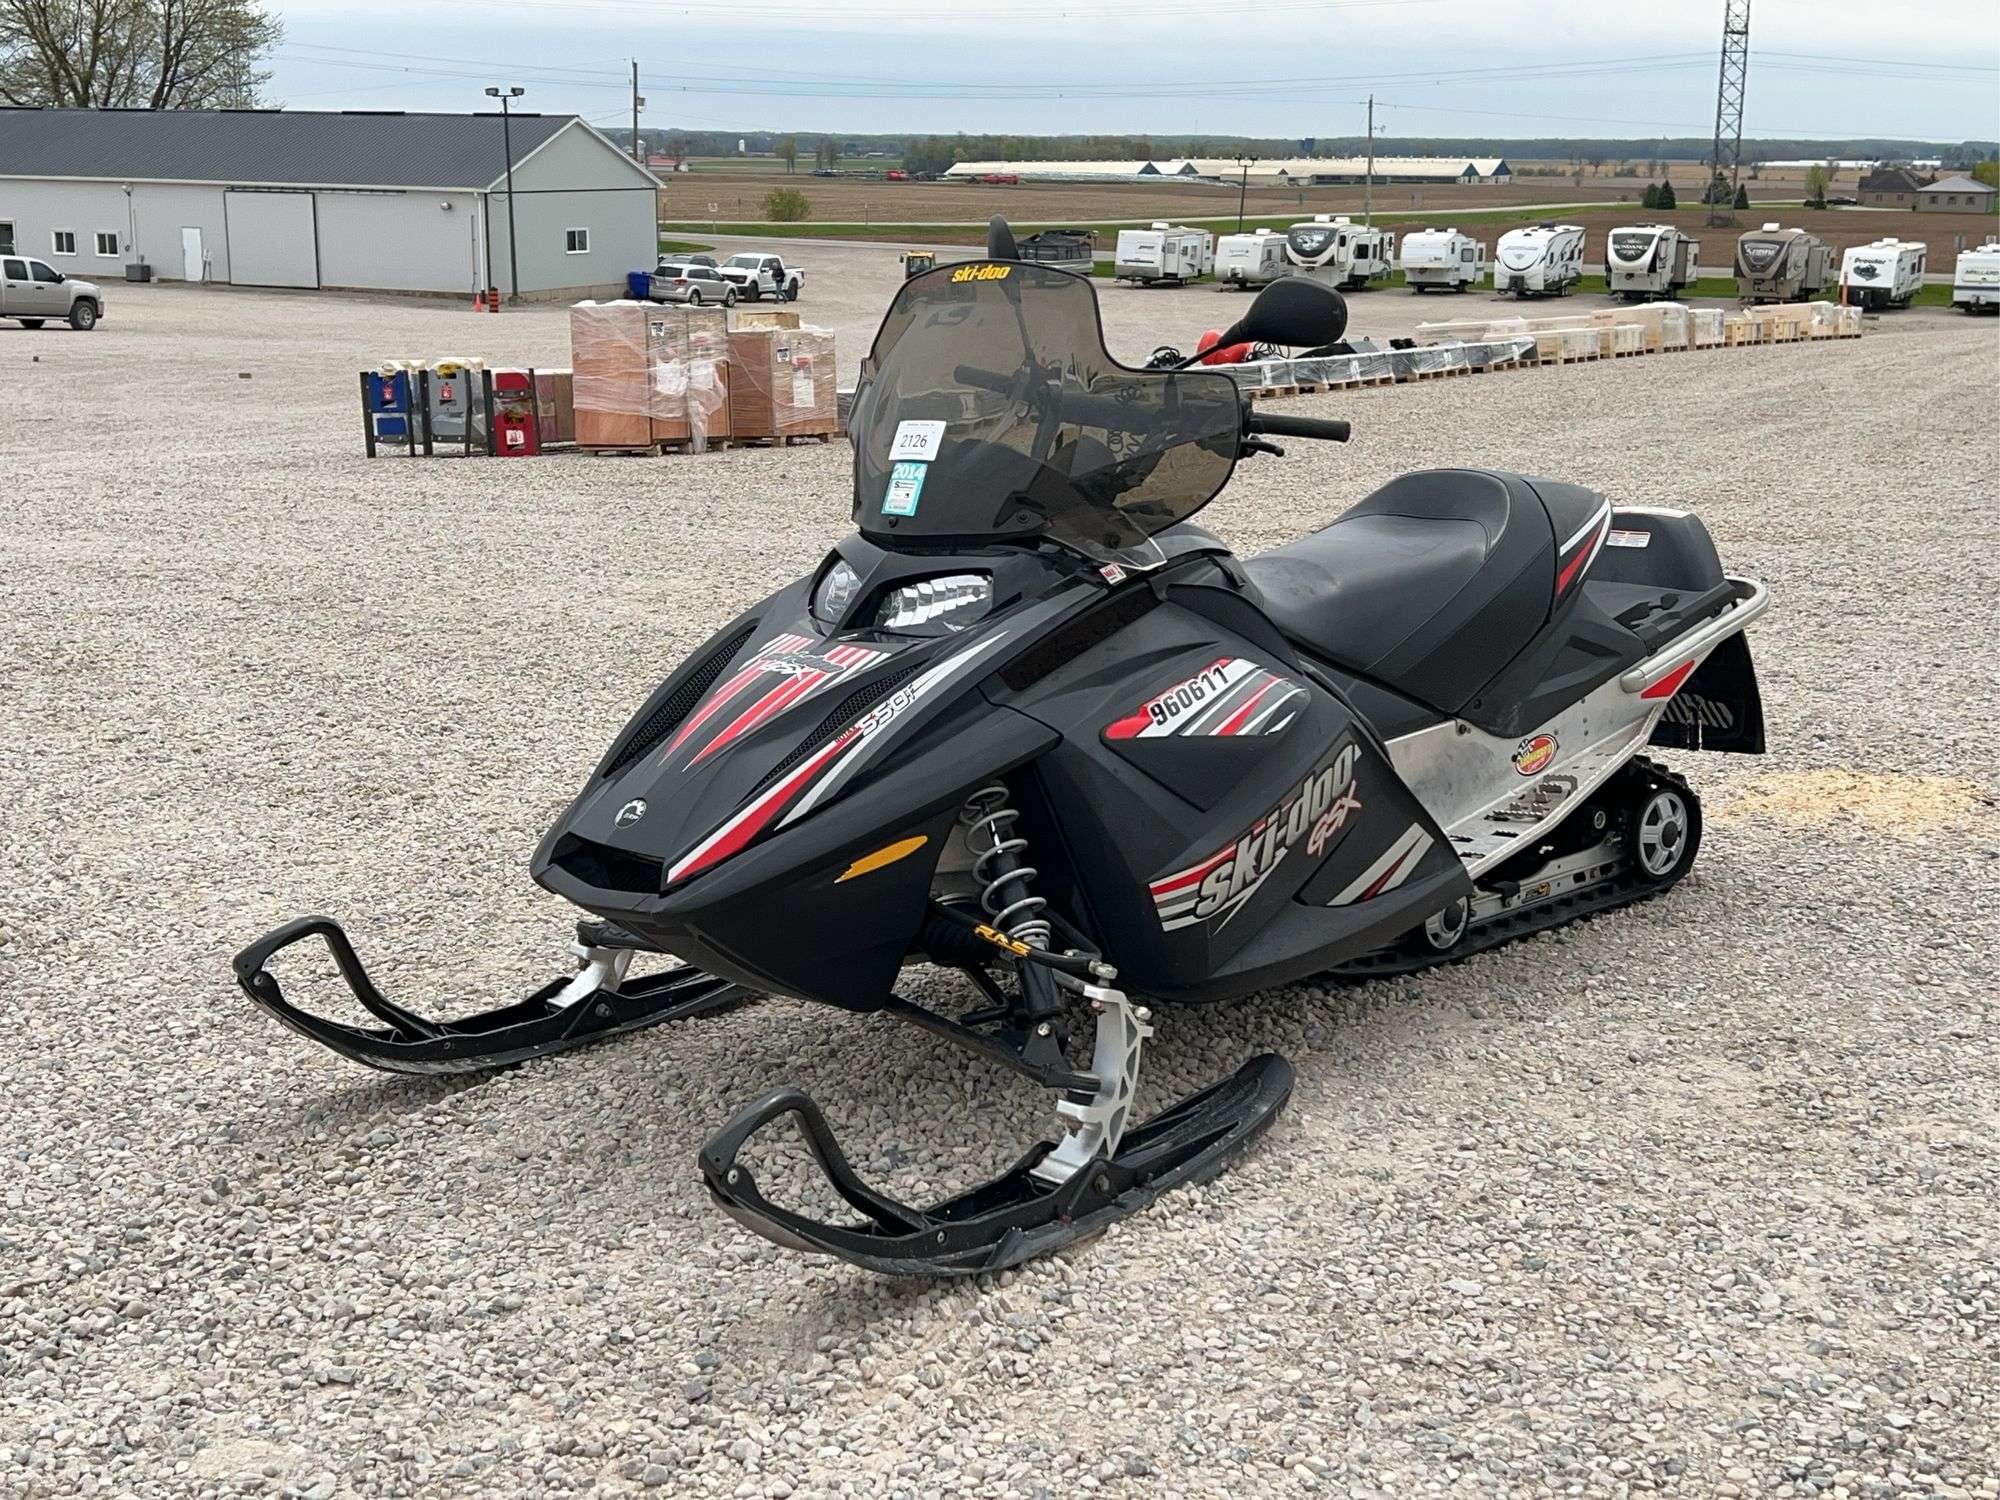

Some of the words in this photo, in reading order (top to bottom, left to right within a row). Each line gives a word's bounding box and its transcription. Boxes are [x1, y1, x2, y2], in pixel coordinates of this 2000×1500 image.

[951, 264, 1013, 283] ski-doo
[899, 434, 929, 448] 2126
[891, 464, 924, 480] 2014
[1149, 666, 1229, 726] 960611
[1194, 745, 1356, 919] ski-doo
[1306, 781, 1362, 857] GSX
